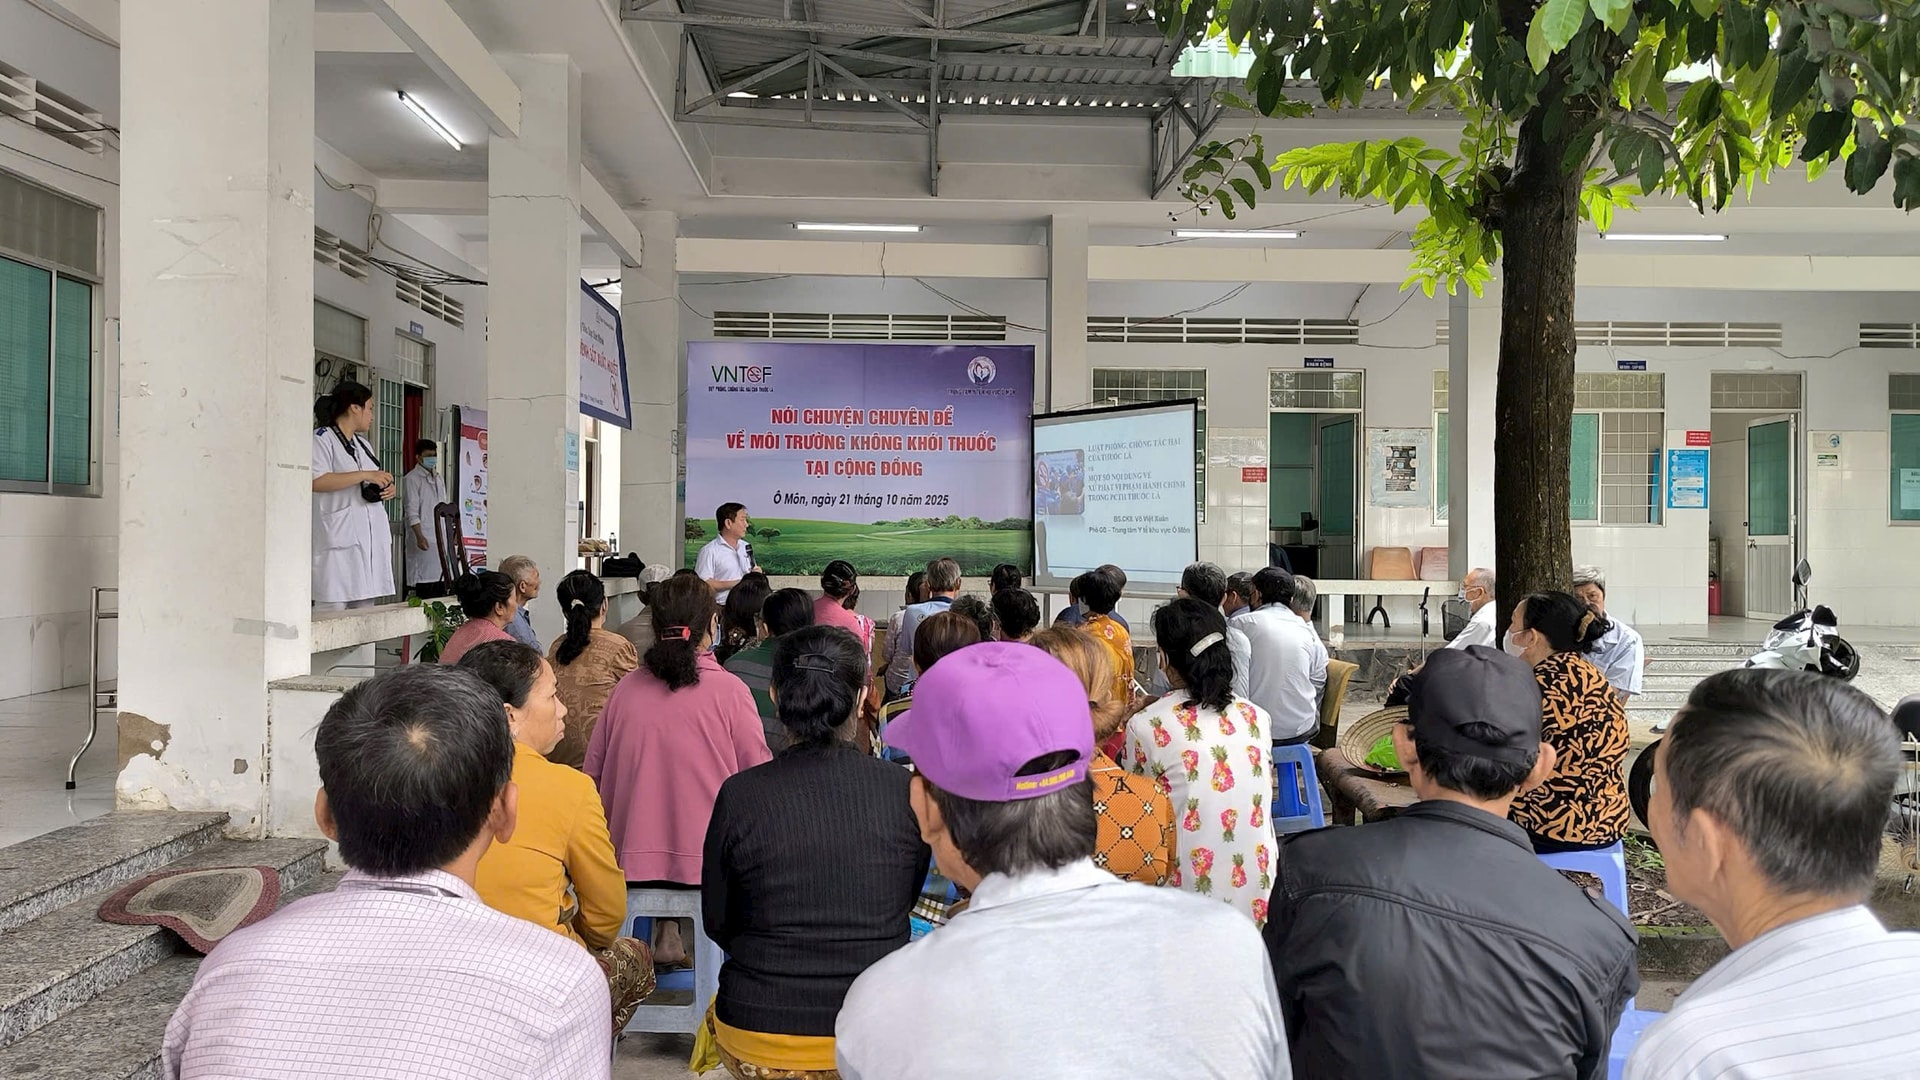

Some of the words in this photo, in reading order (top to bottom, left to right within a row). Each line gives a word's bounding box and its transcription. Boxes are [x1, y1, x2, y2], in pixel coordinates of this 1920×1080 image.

[771, 405, 798, 424] NÓI
[803, 407, 864, 428] CHUYỆN
[868, 408, 929, 426] CHUYÊN
[933, 406, 953, 426] ĐỀ
[726, 429, 745, 449] VỀ
[750, 431, 780, 449] MÔI
[784, 432, 846, 450] TRƯỜNG
[850, 432, 902, 451] KHÔNG
[907, 433, 943, 451] KHÓI
[947, 431, 997, 452] THUỐC
[805, 460, 829, 479] TẠI
[834, 458, 876, 479] CỘNG
[880, 456, 923, 476] ĐỒNG
[773, 490, 782, 505] Ô
[784, 492, 809, 506] Môn,
[811, 492, 838, 507] ngày
[839, 493, 851, 505] 21
[853, 492, 883, 508] tháng
[886, 494, 898, 505] 10
[900, 493, 922, 506] năm
[924, 494, 949, 506] 2025
